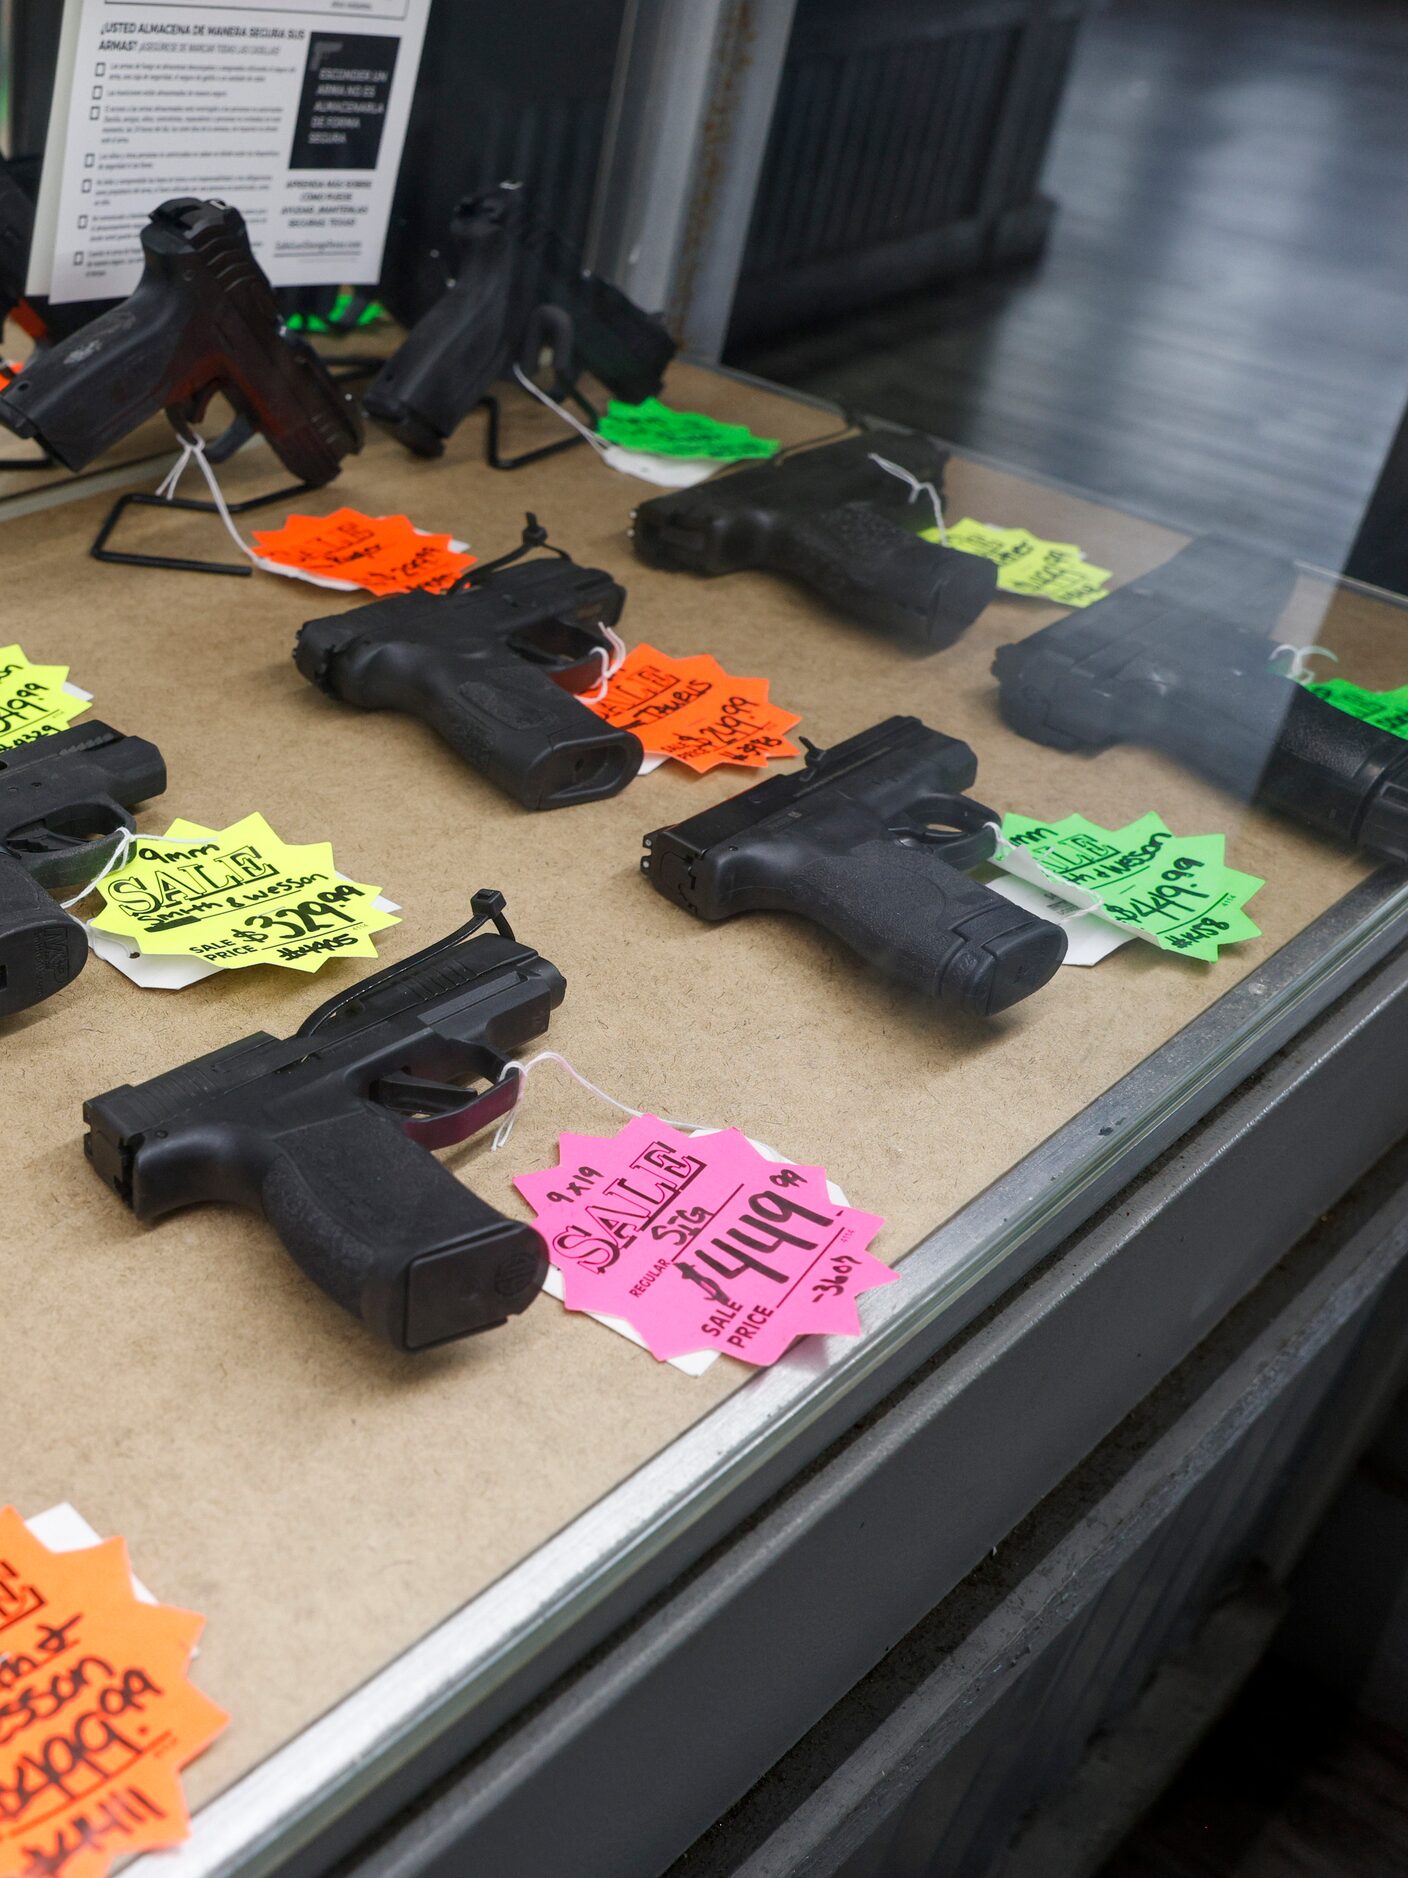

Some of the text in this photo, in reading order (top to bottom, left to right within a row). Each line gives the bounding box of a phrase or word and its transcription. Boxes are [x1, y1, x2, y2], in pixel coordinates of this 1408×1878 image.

[138, 23, 191, 35] ALMACENA
[192, 24, 205, 35] DE
[207, 25, 245, 37] MANERA
[249, 27, 284, 39] SEGURA
[287, 28, 305, 39] SUS
[373, 69, 389, 83] UN
[346, 84, 362, 97] NO
[363, 85, 376, 98] ES
[312, 99, 385, 115] ALMACENARLA
[310, 116, 324, 128] DE
[138, 843, 220, 865] 9mm
[107, 844, 281, 917] SALE
[136, 899, 223, 926] Smith
[189, 938, 237, 954] SALE
[207, 947, 258, 962] PRICE
[551, 1139, 709, 1275] SALE
[628, 1256, 673, 1300] REGULAR
[700, 1298, 745, 1338] SALE
[726, 1303, 776, 1350] PRICE
